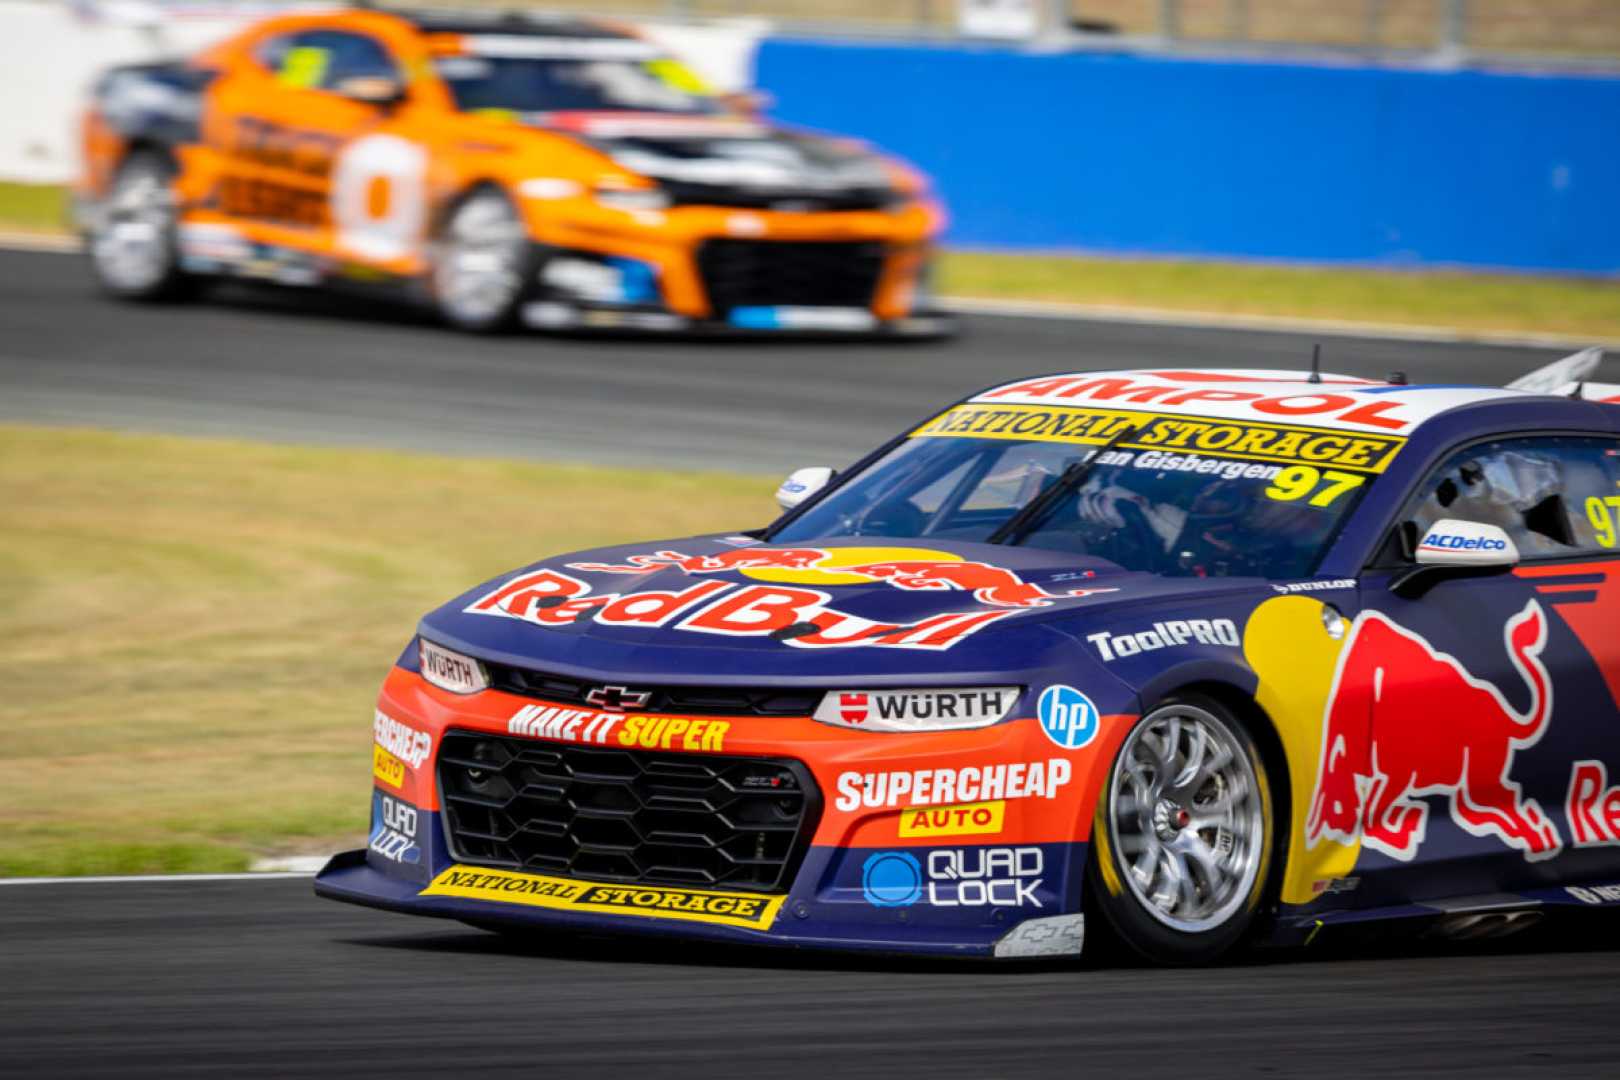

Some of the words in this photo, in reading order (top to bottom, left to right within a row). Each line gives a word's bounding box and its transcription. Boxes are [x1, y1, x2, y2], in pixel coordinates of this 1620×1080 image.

[985, 377, 1408, 431] AMPOL
[926, 410, 1131, 440] NATIONAL
[1140, 419, 1388, 466] STORAGE
[1133, 450, 1283, 480] Gisbergen
[1265, 466, 1366, 507] 97
[1423, 533, 1506, 551] ACDelco
[1286, 578, 1356, 592] DUNLOP
[462, 568, 739, 627] Red
[673, 584, 1031, 650] Bull
[1087, 618, 1242, 662] ToolPRO
[426, 646, 474, 687] WÜRTH
[876, 691, 1002, 720] WÜRTH
[1049, 687, 1089, 747] hp
[508, 703, 592, 741] MAKE
[583, 712, 626, 744] IT
[618, 715, 731, 752] SUPER
[376, 750, 400, 779] AUTO
[835, 758, 1072, 813] SUPERCHEAP
[382, 796, 417, 837] QUAD
[910, 807, 992, 830] AUTO
[370, 825, 415, 863] LOCK
[927, 847, 1044, 880] QUAD
[440, 871, 577, 899] NATIONAL
[590, 887, 763, 917] STORAGE
[927, 878, 1044, 908] LOCK
